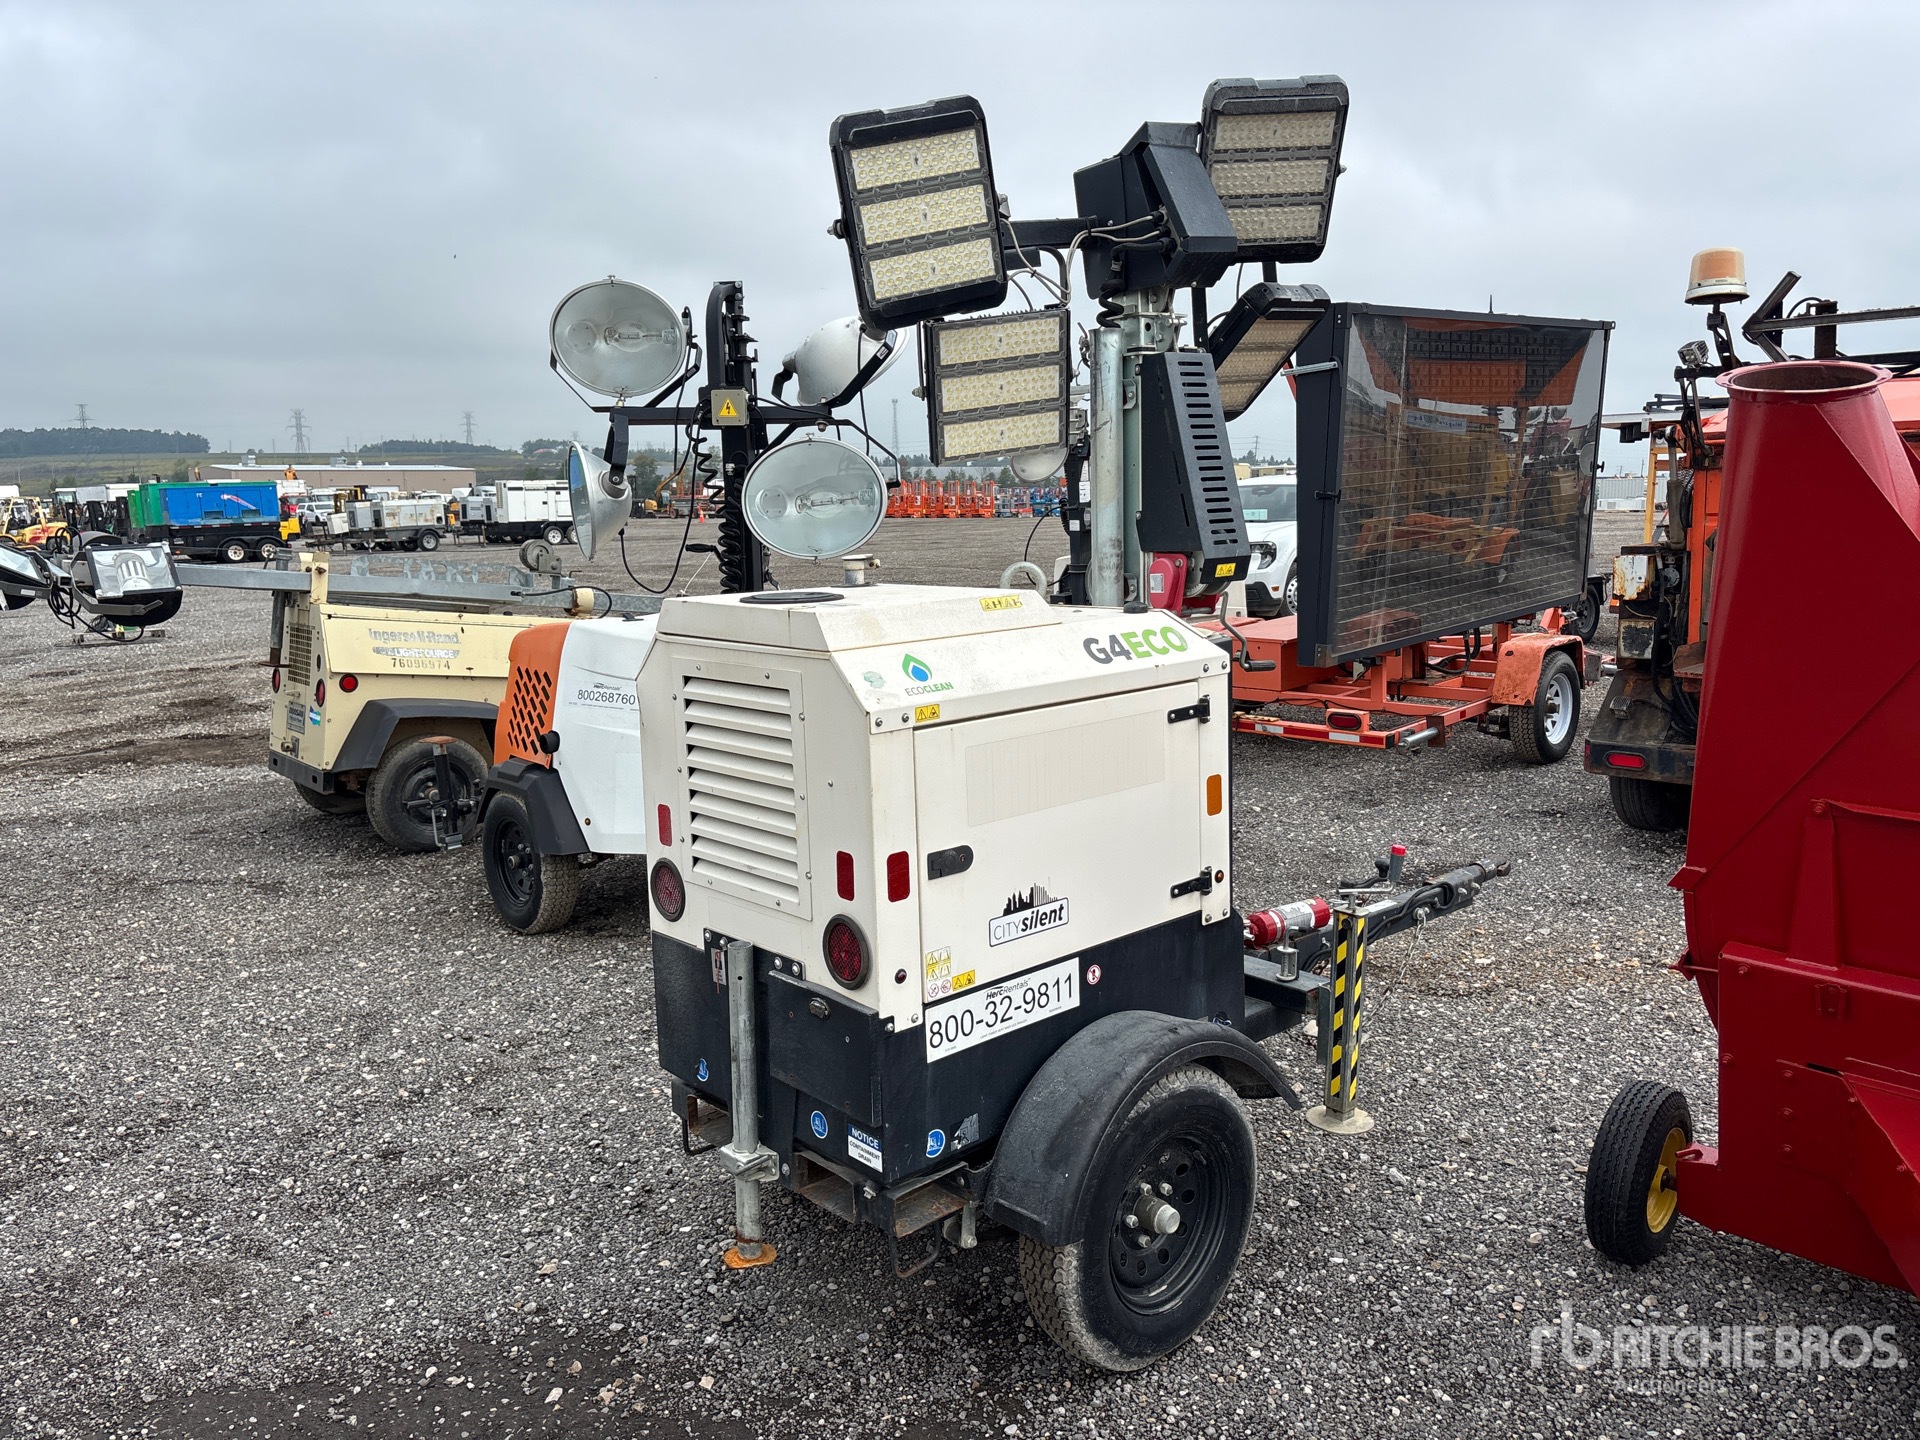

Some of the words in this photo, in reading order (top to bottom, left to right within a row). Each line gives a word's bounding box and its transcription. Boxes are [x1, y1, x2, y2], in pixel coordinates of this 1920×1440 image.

[1082, 626, 1188, 664] G4ECO
[577, 689, 636, 705] 800268760
[904, 682, 954, 697] ECOCLEAN
[993, 903, 1064, 940] CITYsilent
[929, 972, 1073, 1049] 800-32-9811
[851, 1127, 879, 1149] NOTICE
[849, 1140, 880, 1161] CONTAINMENT
[857, 1152, 872, 1164] DRAIN
